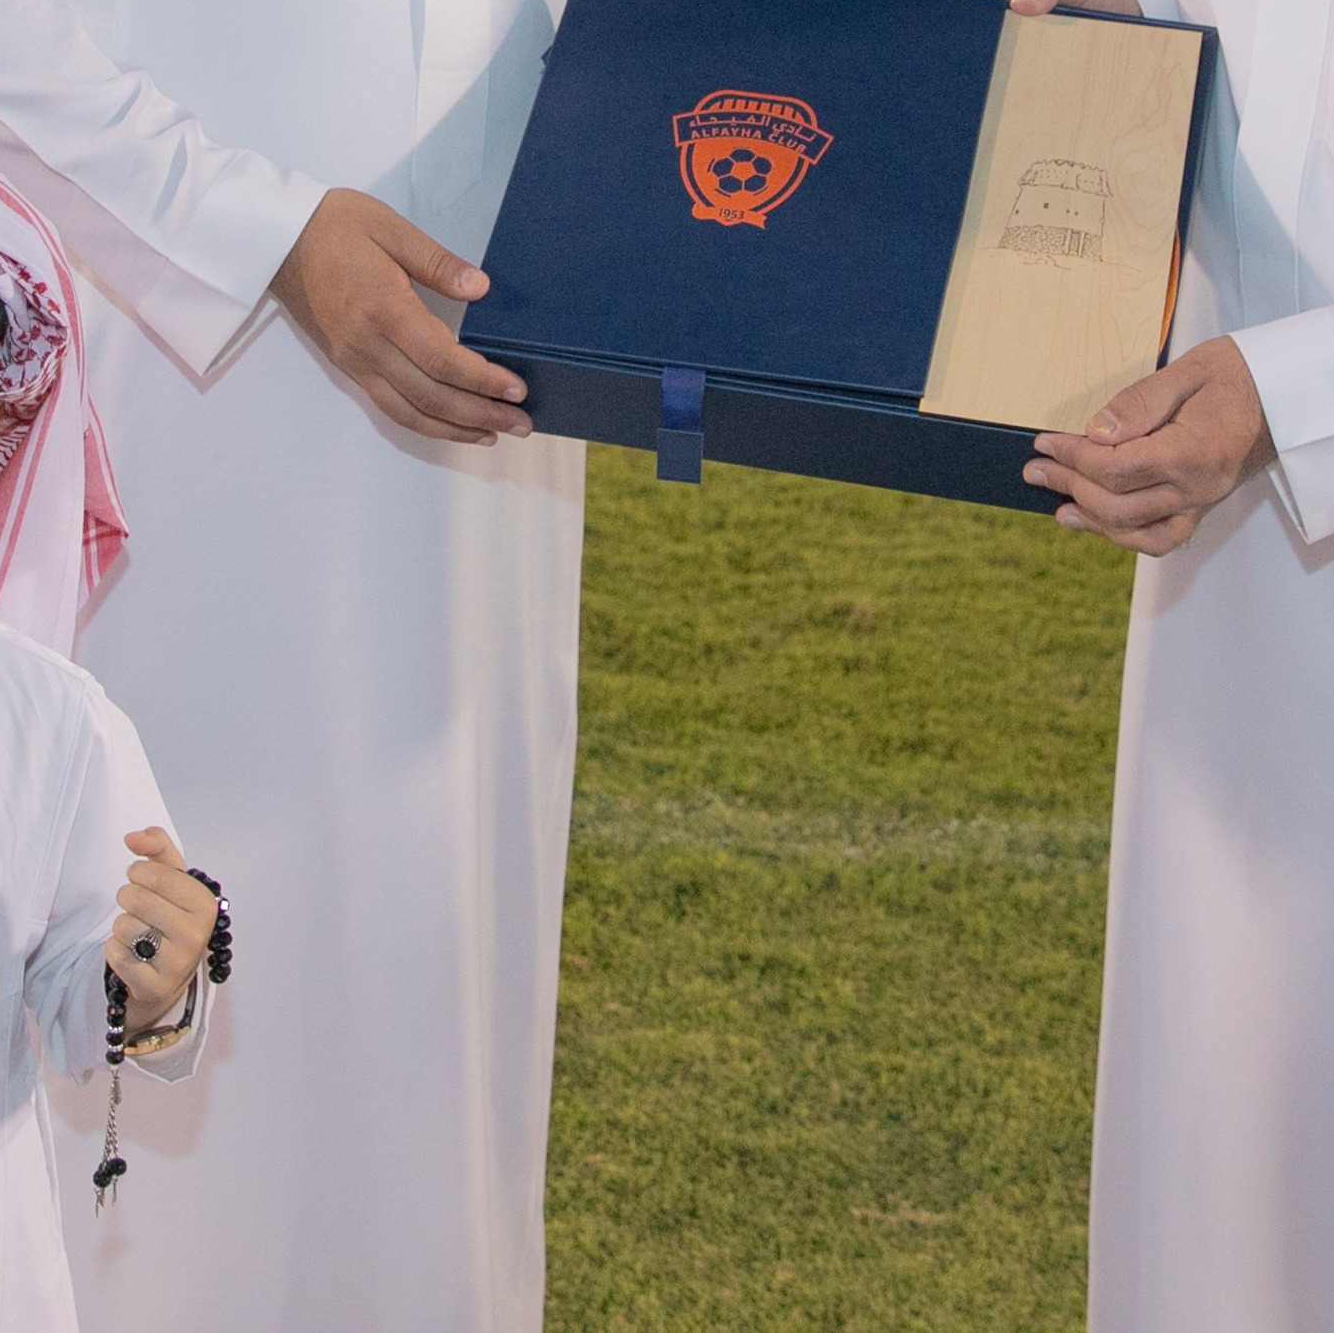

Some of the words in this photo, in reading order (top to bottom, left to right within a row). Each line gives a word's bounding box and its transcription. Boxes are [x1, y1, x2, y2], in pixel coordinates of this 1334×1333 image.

[690, 127, 763, 140] ALFAYHA
[768, 133, 807, 154] CLUB
[718, 207, 745, 220] 1953
